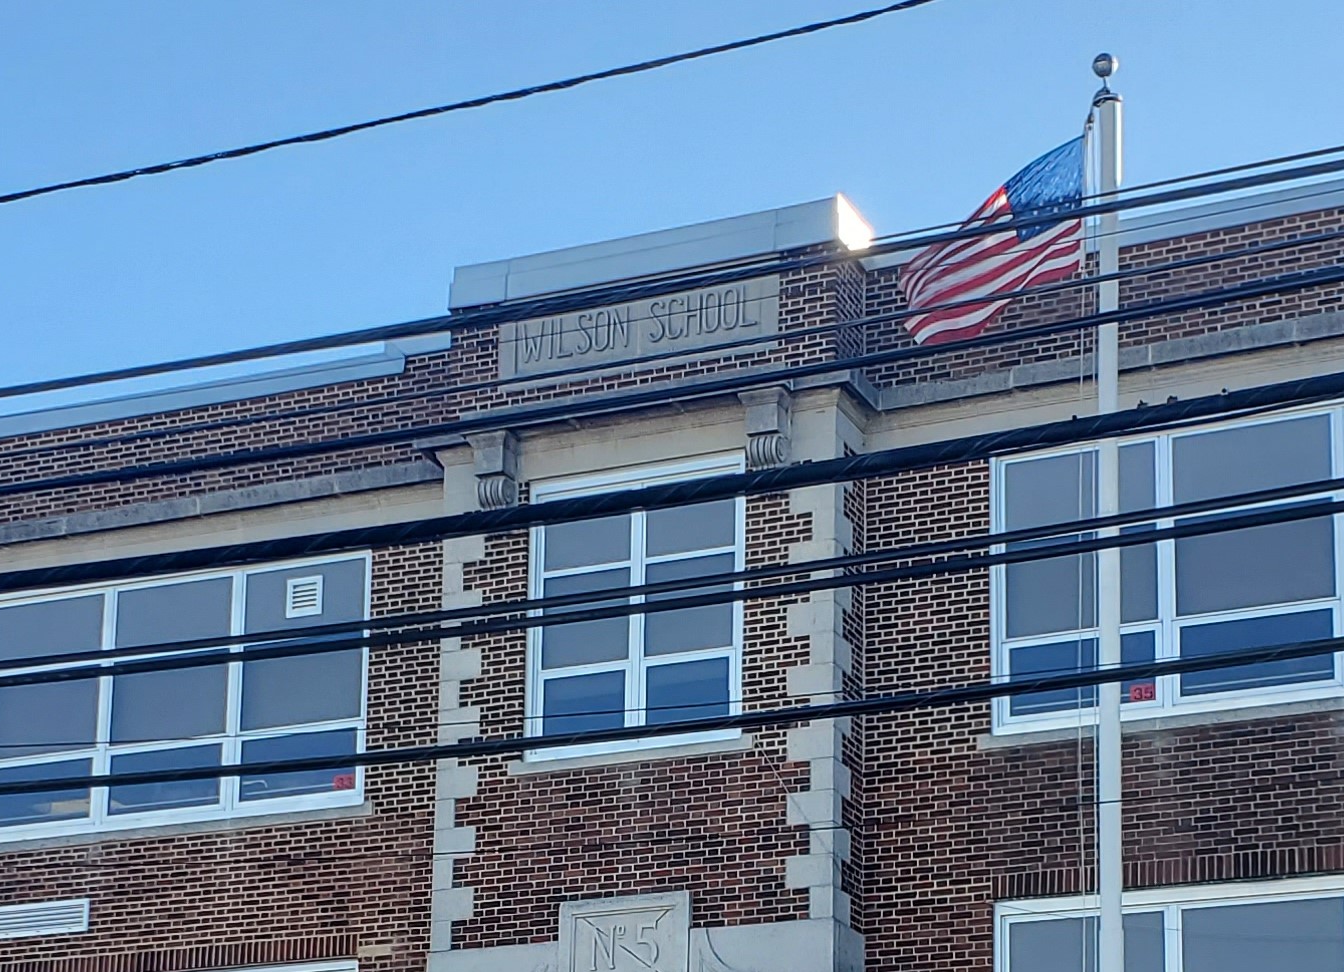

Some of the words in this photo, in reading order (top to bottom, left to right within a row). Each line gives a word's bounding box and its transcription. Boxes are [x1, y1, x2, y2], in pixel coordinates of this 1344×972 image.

[520, 304, 630, 364] WILSON
[648, 283, 758, 342] SCHOOL
[1133, 686, 1153, 700] 35
[636, 922, 660, 965] 5
